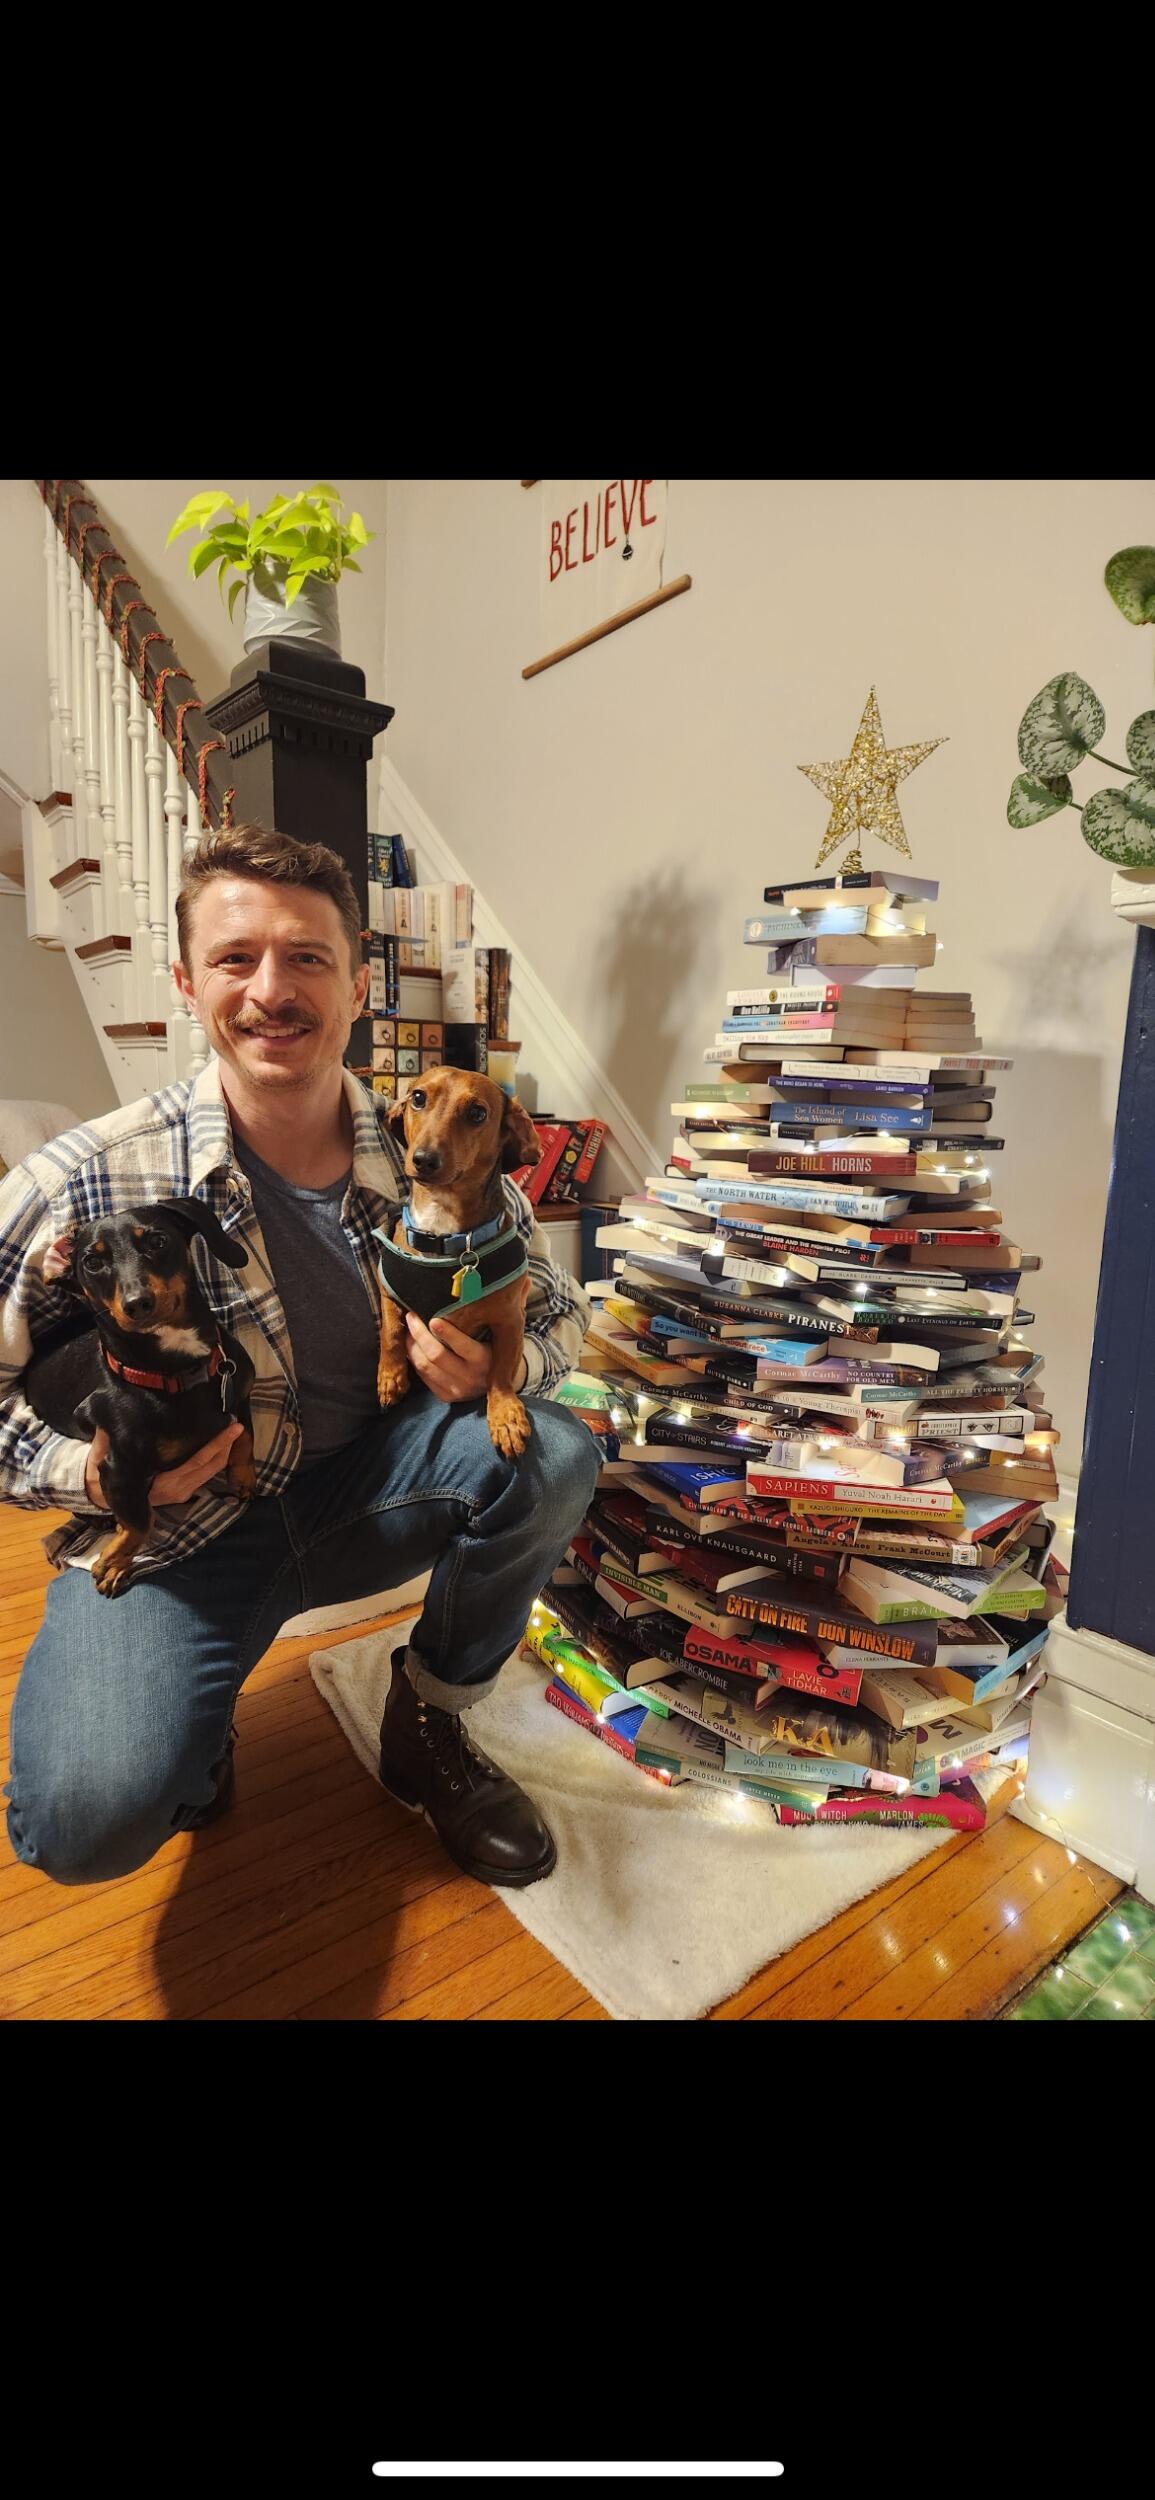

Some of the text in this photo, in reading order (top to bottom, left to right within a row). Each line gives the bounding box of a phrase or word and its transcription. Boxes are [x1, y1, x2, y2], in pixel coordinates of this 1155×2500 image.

[549, 480, 657, 582] BELIEVE
[479, 1027, 487, 1073] SOLENOID
[793, 1105, 900, 1123] The Island of Lisa See
[793, 1114, 844, 1124] Sea Women
[775, 1156, 872, 1173] JOE HILL HORNS
[718, 1187, 747, 1198] NORTH
[748, 1190, 778, 1202] WATER
[735, 1230, 851, 1255] THE GREAT LEADER AND THE FIGHTER PILOT
[762, 1240, 820, 1257] BLAINE HARDEN
[713, 1300, 750, 1314] SUSANNA
[753, 1307, 785, 1321] CLARKE
[906, 1316, 921, 1324] LAST
[922, 1317, 949, 1326] EVENINGS
[959, 1318, 977, 1327] EARTH
[654, 1321, 664, 1330] So
[665, 1324, 679, 1334] you
[679, 1326, 699, 1338] want
[699, 1330, 707, 1339] to
[749, 1343, 766, 1354] race
[765, 1368, 841, 1381] Cormac McCarthy
[847, 1370, 895, 1379] NO COUNTRY
[879, 1377, 896, 1385] MEN
[642, 1384, 670, 1396] Cormac
[672, 1388, 709, 1402] McCarthy
[723, 1398, 745, 1408] CHILD
[746, 1402, 756, 1410] OF
[756, 1403, 774, 1413] GOD
[888, 1391, 917, 1399] McCarthy
[955, 1387, 982, 1396] PRETTY
[982, 1386, 1009, 1395] HORSES
[651, 1427, 671, 1439] CITY
[676, 1431, 708, 1447] STAIRS
[710, 1439, 727, 1449] ROBERT
[921, 1427, 959, 1436] PRIEST
[934, 1461, 963, 1472] McCarthy
[765, 1479, 923, 1505] SAPIENS Yuval Noah Harari
[809, 1504, 832, 1512] KAZUO
[831, 1504, 864, 1513] ISHIGURO
[867, 1507, 881, 1515] THE
[881, 1508, 910, 1516] REMAINS
[933, 1511, 947, 1519] DAY
[749, 1514, 773, 1525] DECLINE
[782, 1520, 803, 1532] GEORGE
[805, 1524, 835, 1538] SAUNDERS
[655, 1524, 680, 1537] KARL
[683, 1531, 703, 1544] OVE
[706, 1536, 778, 1564] KNAUSGAARD
[877, 1543, 907, 1553] Frank
[908, 1546, 951, 1559] McCourt
[604, 1566, 644, 1591] INVISIBLE
[642, 1583, 661, 1599] MAN
[726, 1594, 917, 1662] CITY ON FIRE DON WINSLOW
[686, 1642, 754, 1673] OSAMA
[659, 1648, 729, 1692] JOE ABERCROMBIE
[792, 1669, 824, 1687] LAVIE
[786, 1677, 828, 1697] TIDHAR
[549, 1691, 562, 1711] TAD
[673, 1700, 711, 1728] MICHELLE
[712, 1721, 744, 1745] OBAMA
[958, 1740, 986, 1759] MAGIC
[743, 1755, 839, 1777] look me in the eye
[687, 1768, 733, 1787] COLOSSIANS
[820, 1810, 847, 1821] WITCH
[879, 1809, 914, 1821] MARLON
